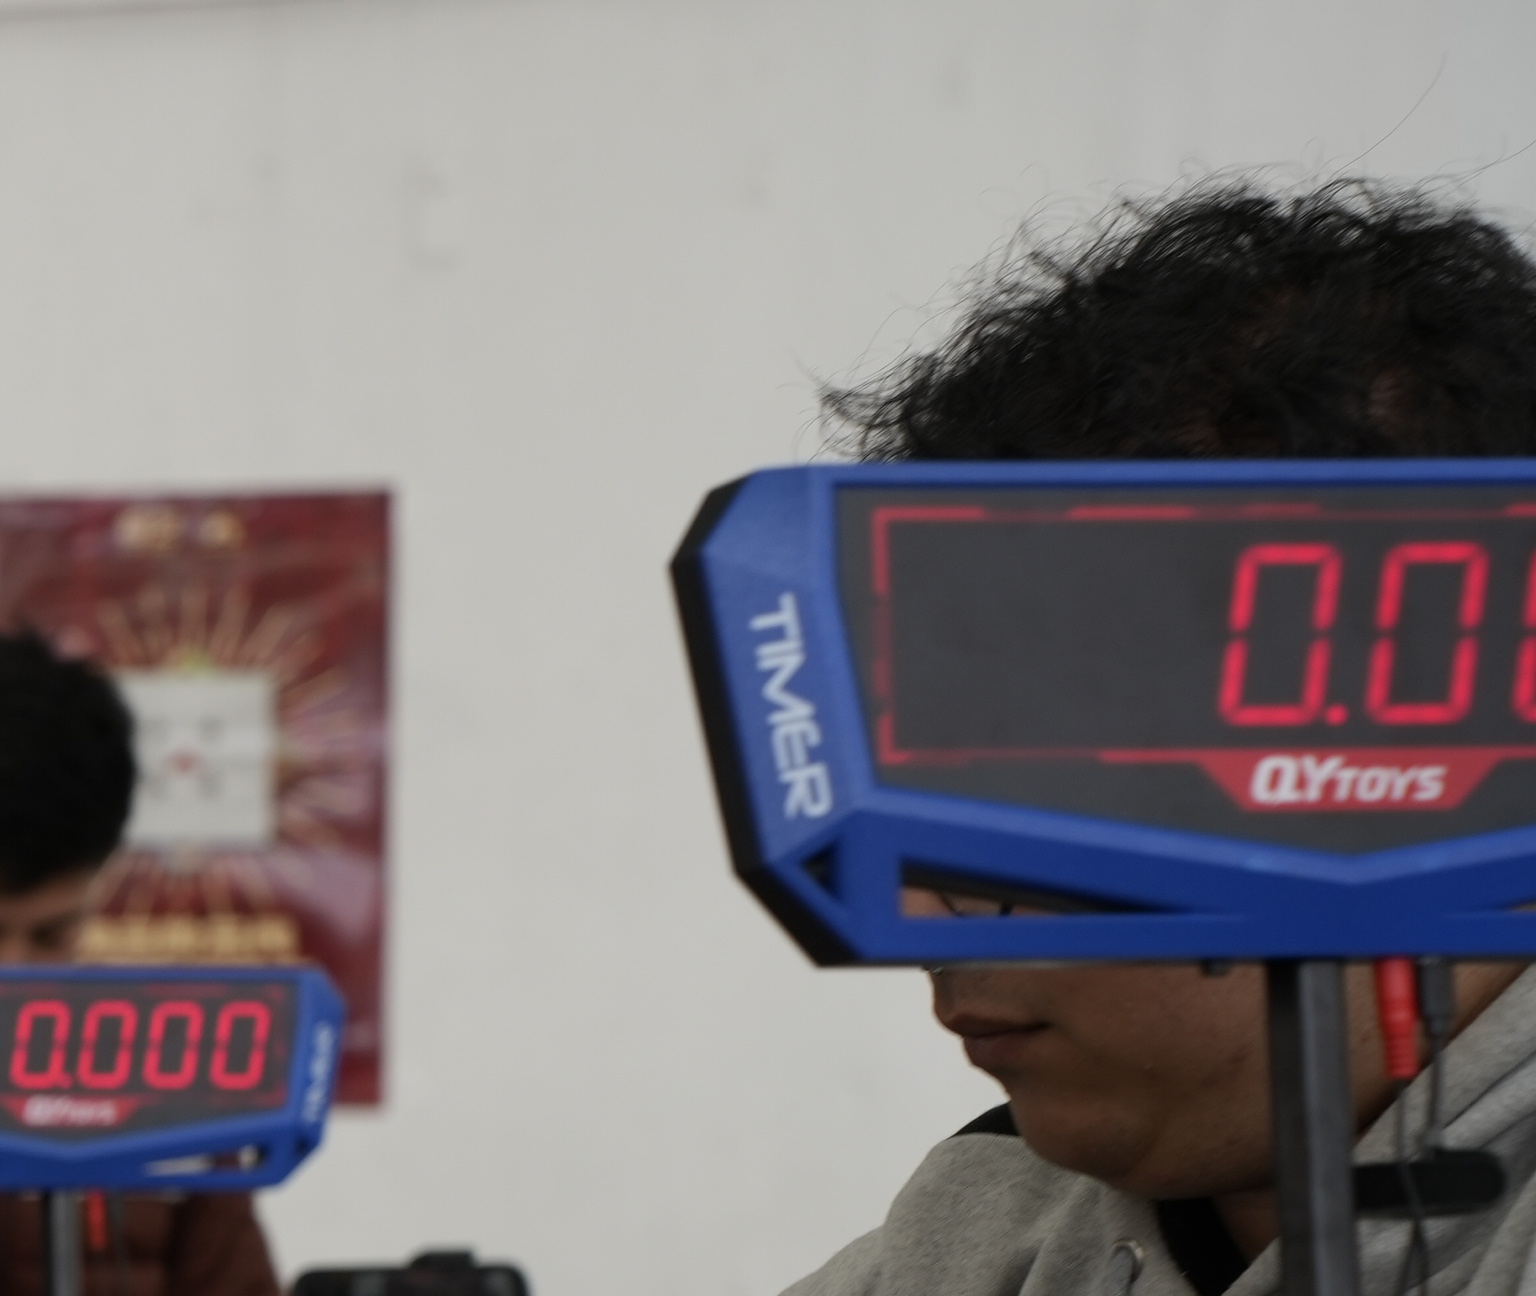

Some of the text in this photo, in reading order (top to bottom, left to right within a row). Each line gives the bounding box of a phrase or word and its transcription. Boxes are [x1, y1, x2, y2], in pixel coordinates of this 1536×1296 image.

[748, 591, 832, 820] TIMER
[1218, 541, 1536, 727] 0.0
[9, 1000, 271, 1090] 0.000
